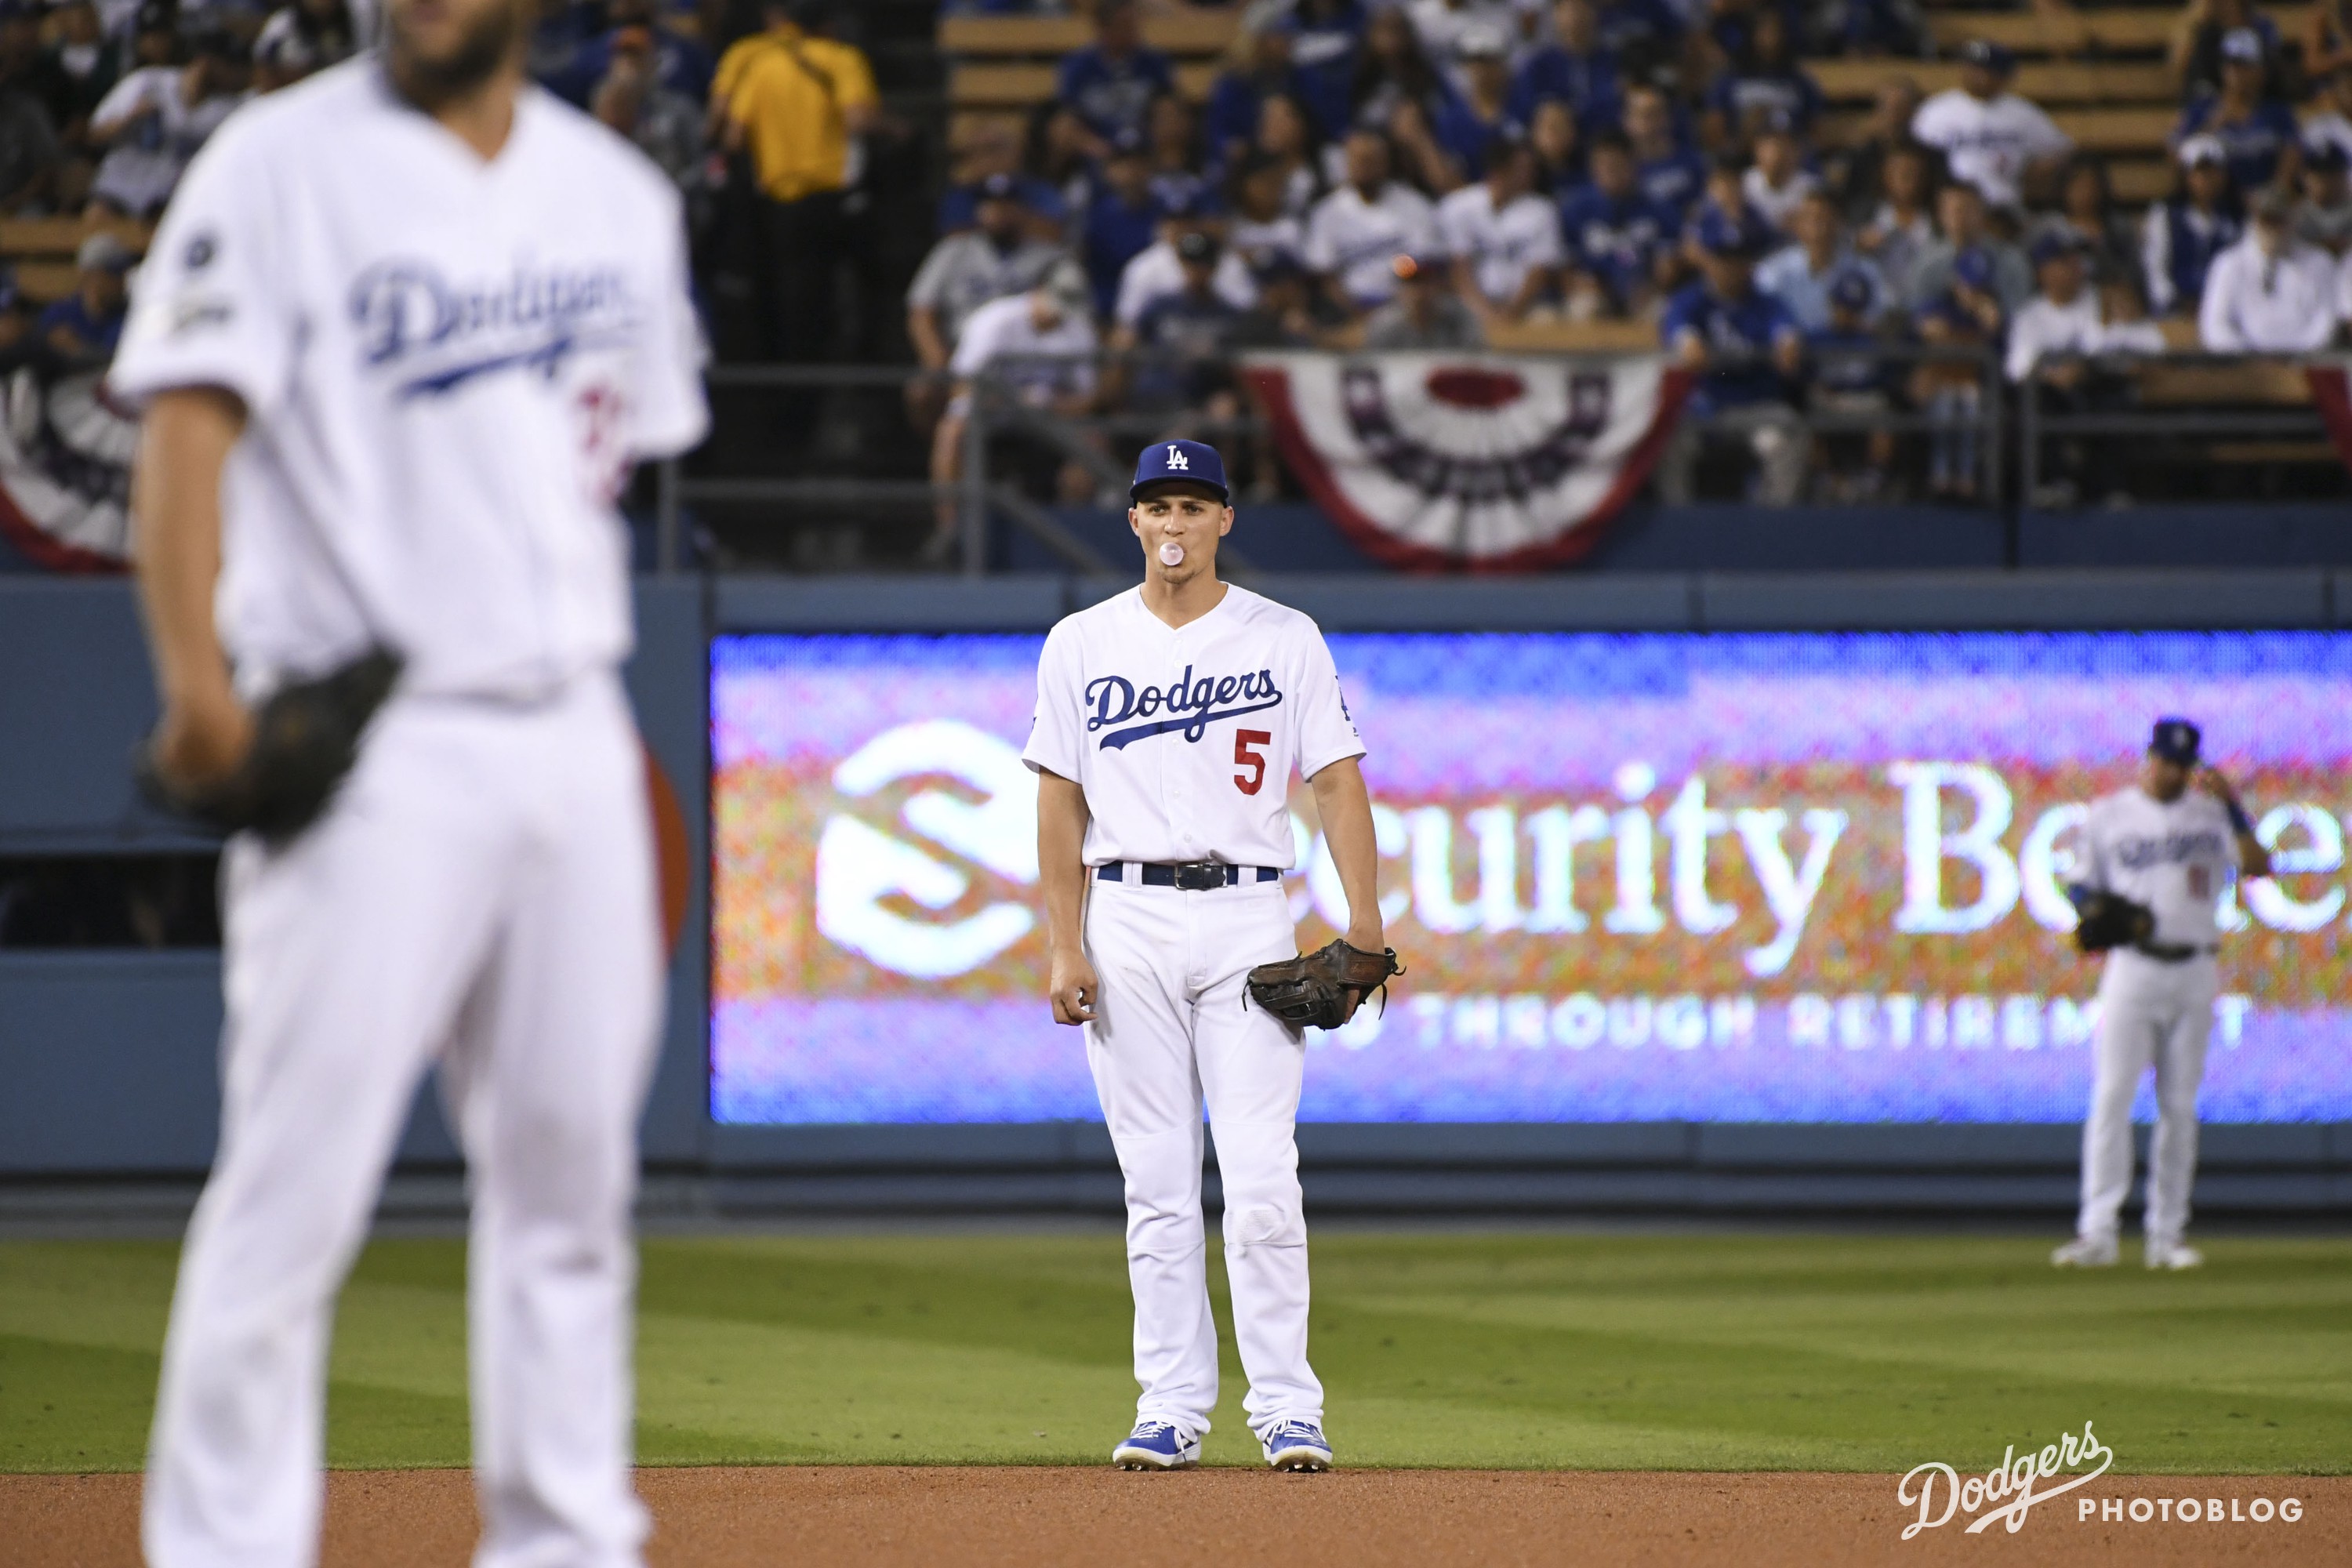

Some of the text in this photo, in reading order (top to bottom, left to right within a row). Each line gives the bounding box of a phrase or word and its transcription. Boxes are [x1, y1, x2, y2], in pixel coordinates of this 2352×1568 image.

[1167, 445, 1189, 470] LA
[1085, 664, 1283, 751] Dodgers
[1233, 728, 1272, 796] 5
[1409, 992, 1756, 1051] THROUGH
[1788, 993, 2253, 1050] RETIREMT
